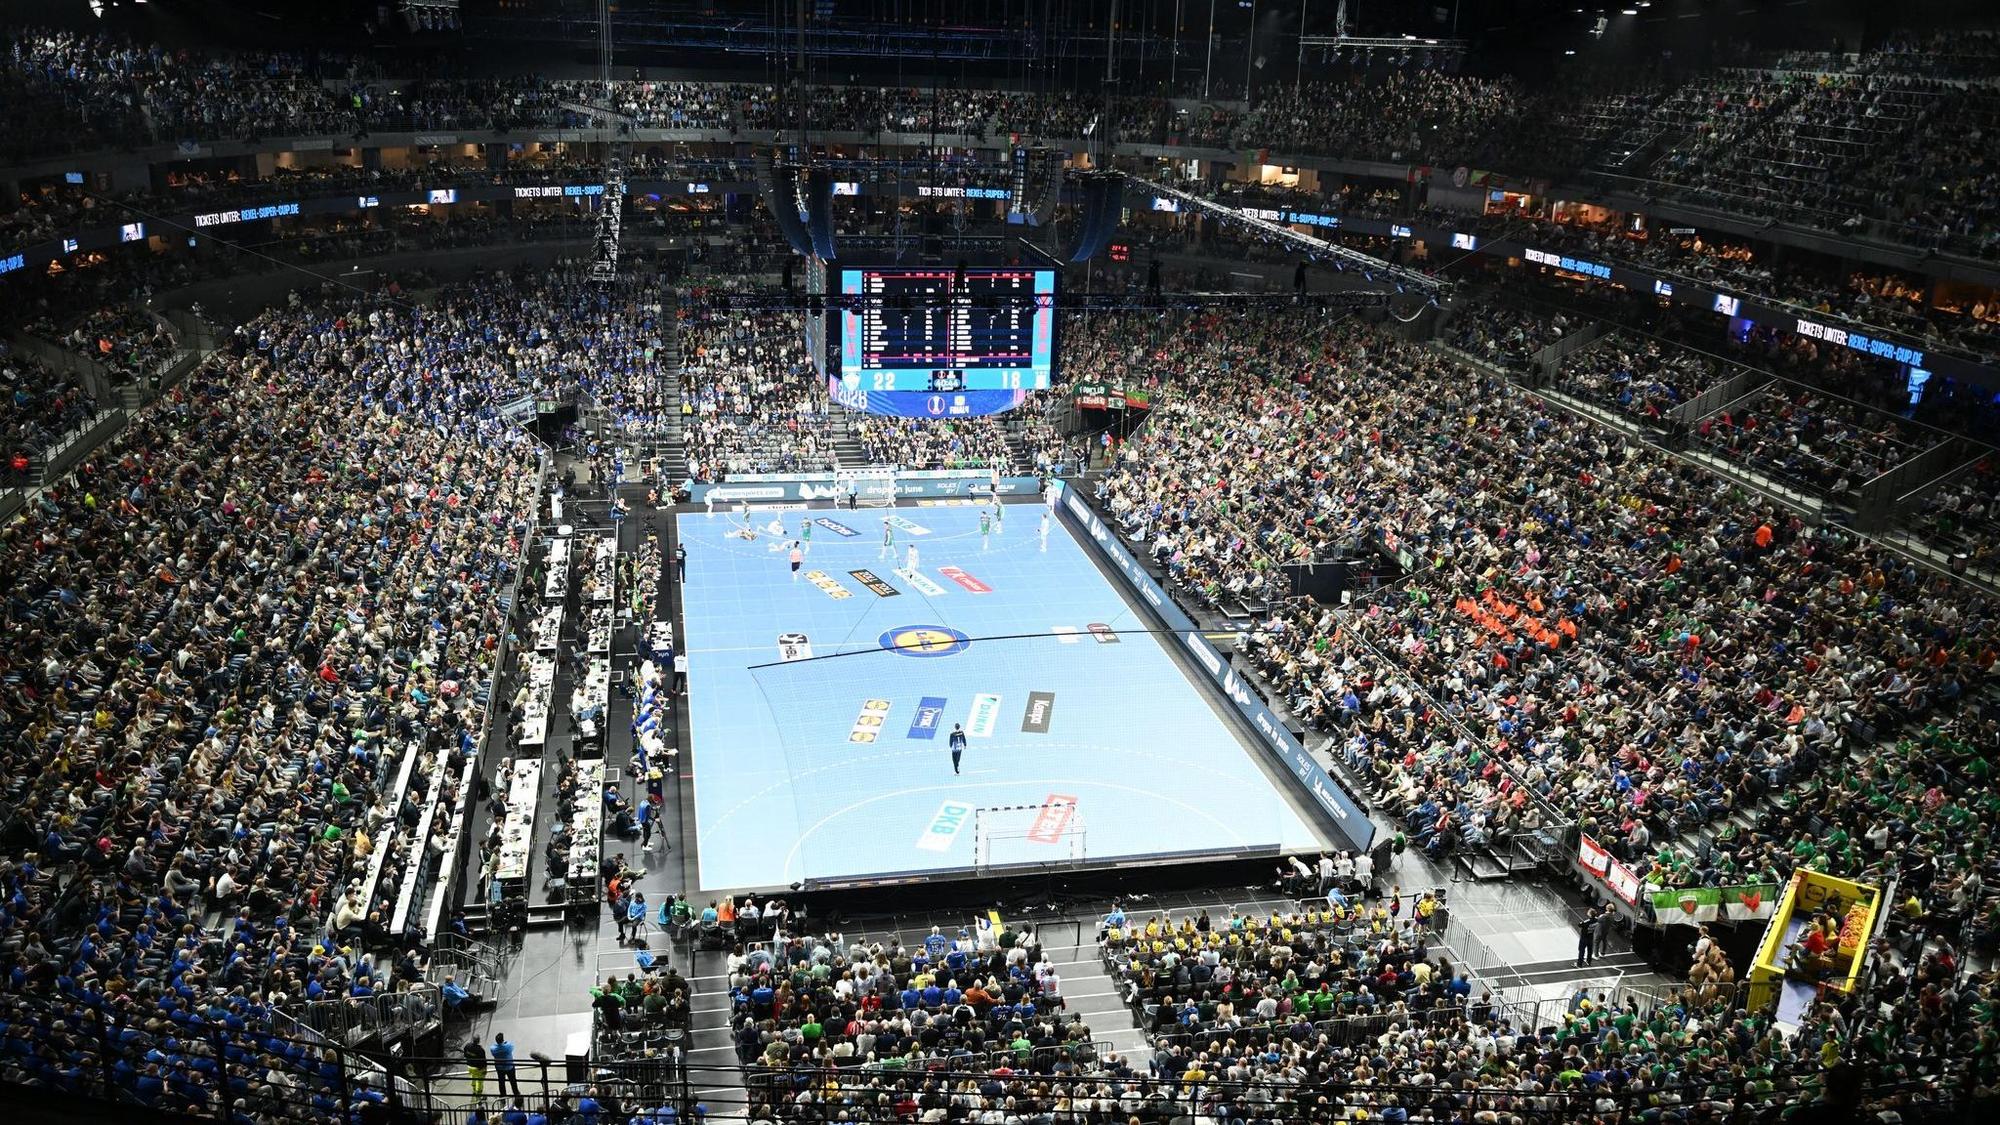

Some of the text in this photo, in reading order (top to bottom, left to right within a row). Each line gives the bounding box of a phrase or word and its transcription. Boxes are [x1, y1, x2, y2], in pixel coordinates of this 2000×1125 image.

[514, 187, 541, 198] TICKETS
[194, 203, 300, 228] TICKETS UNTER: REXEL-SUPER-CUP.DE
[1524, 248, 1544, 264] TICKETS
[1797, 319, 1924, 367] TICKETS UNTER: REXEL-SUPER-CUP.DE
[873, 371, 1021, 391] 22 18
[1296, 753, 1312, 771] SOLES
[1299, 767, 1308, 777] BY
[1321, 789, 1348, 820] MICHELIN
[931, 805, 967, 835] DKB
